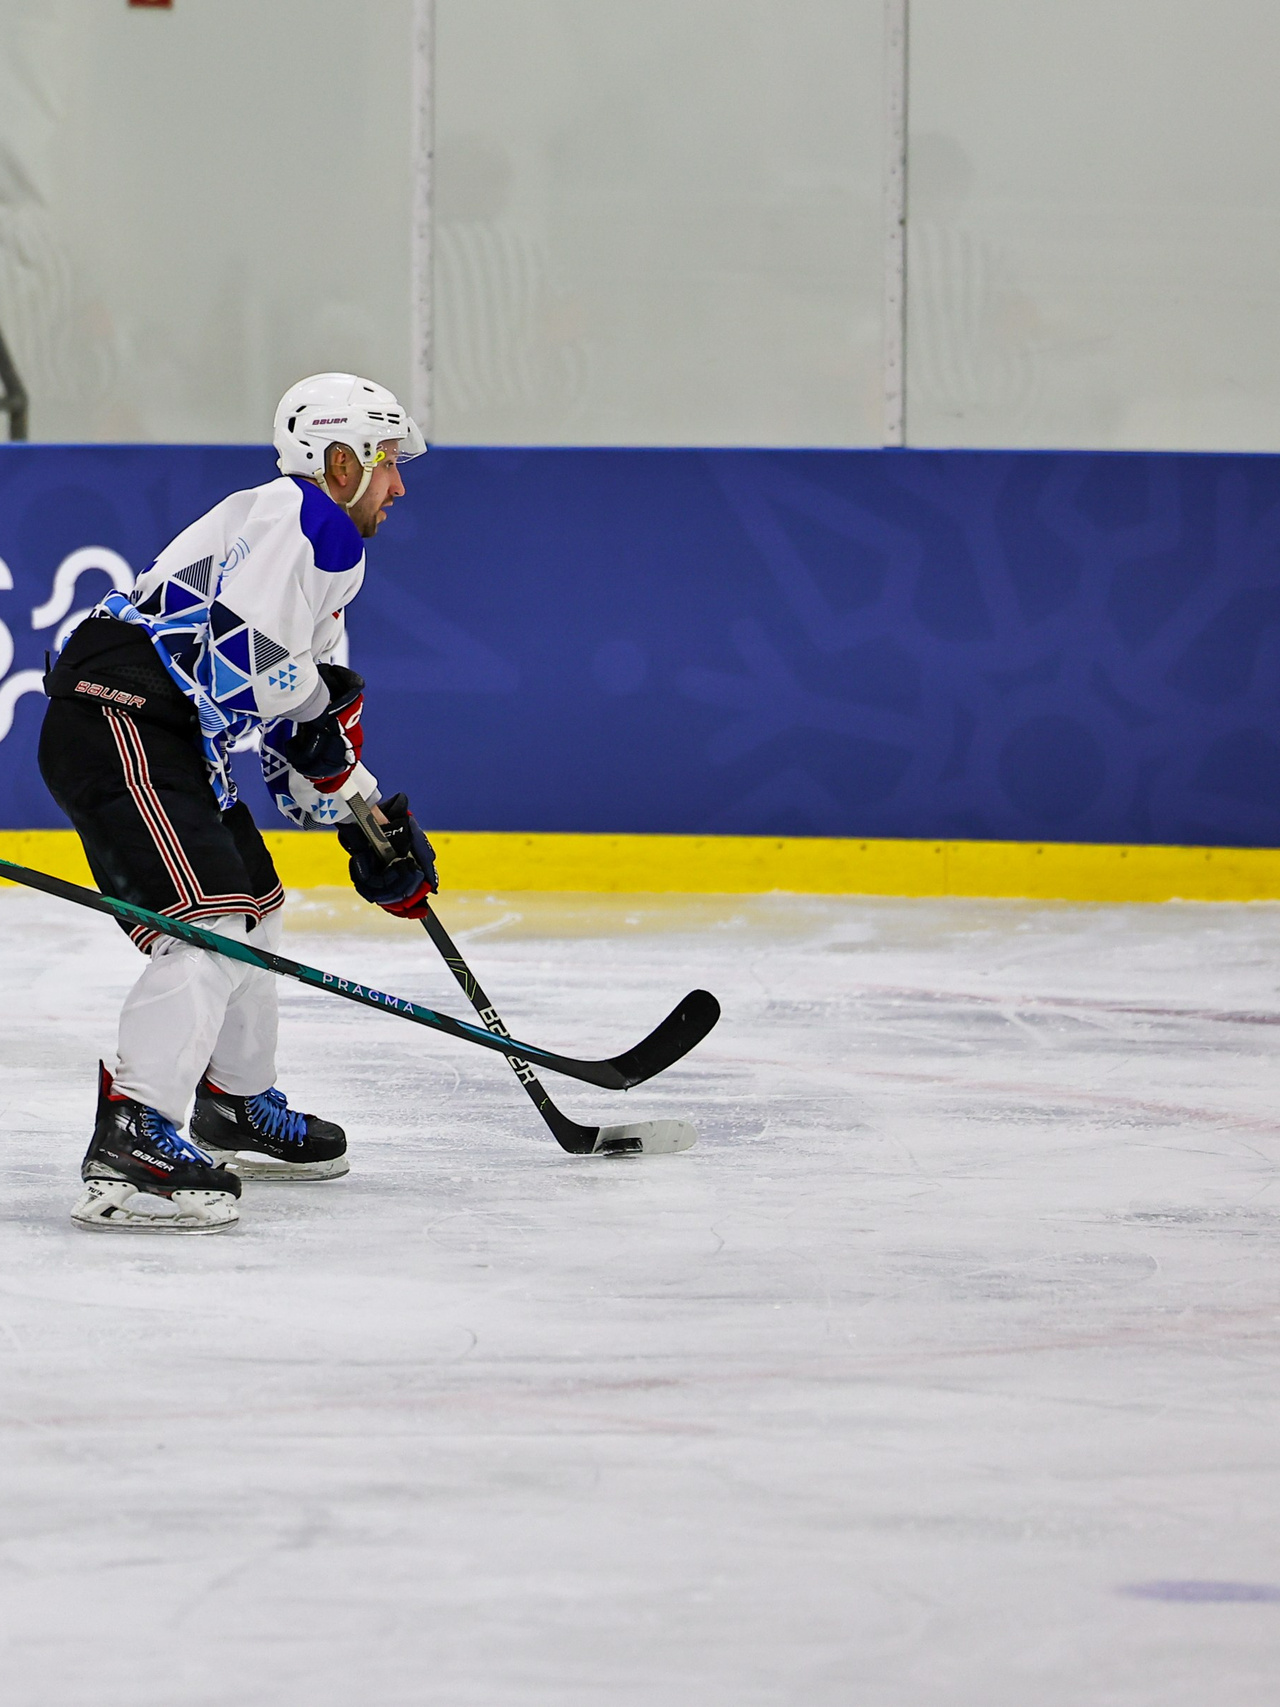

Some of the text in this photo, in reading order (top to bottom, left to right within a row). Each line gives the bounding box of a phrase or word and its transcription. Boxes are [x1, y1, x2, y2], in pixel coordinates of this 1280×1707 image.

[312, 417, 348, 425] BAUER
[74, 680, 147, 709] BAUER
[384, 826, 404, 837] CM
[322, 972, 415, 1015] PRAGMA
[479, 1005, 538, 1085] BAER
[131, 1149, 175, 1172] BAUER
